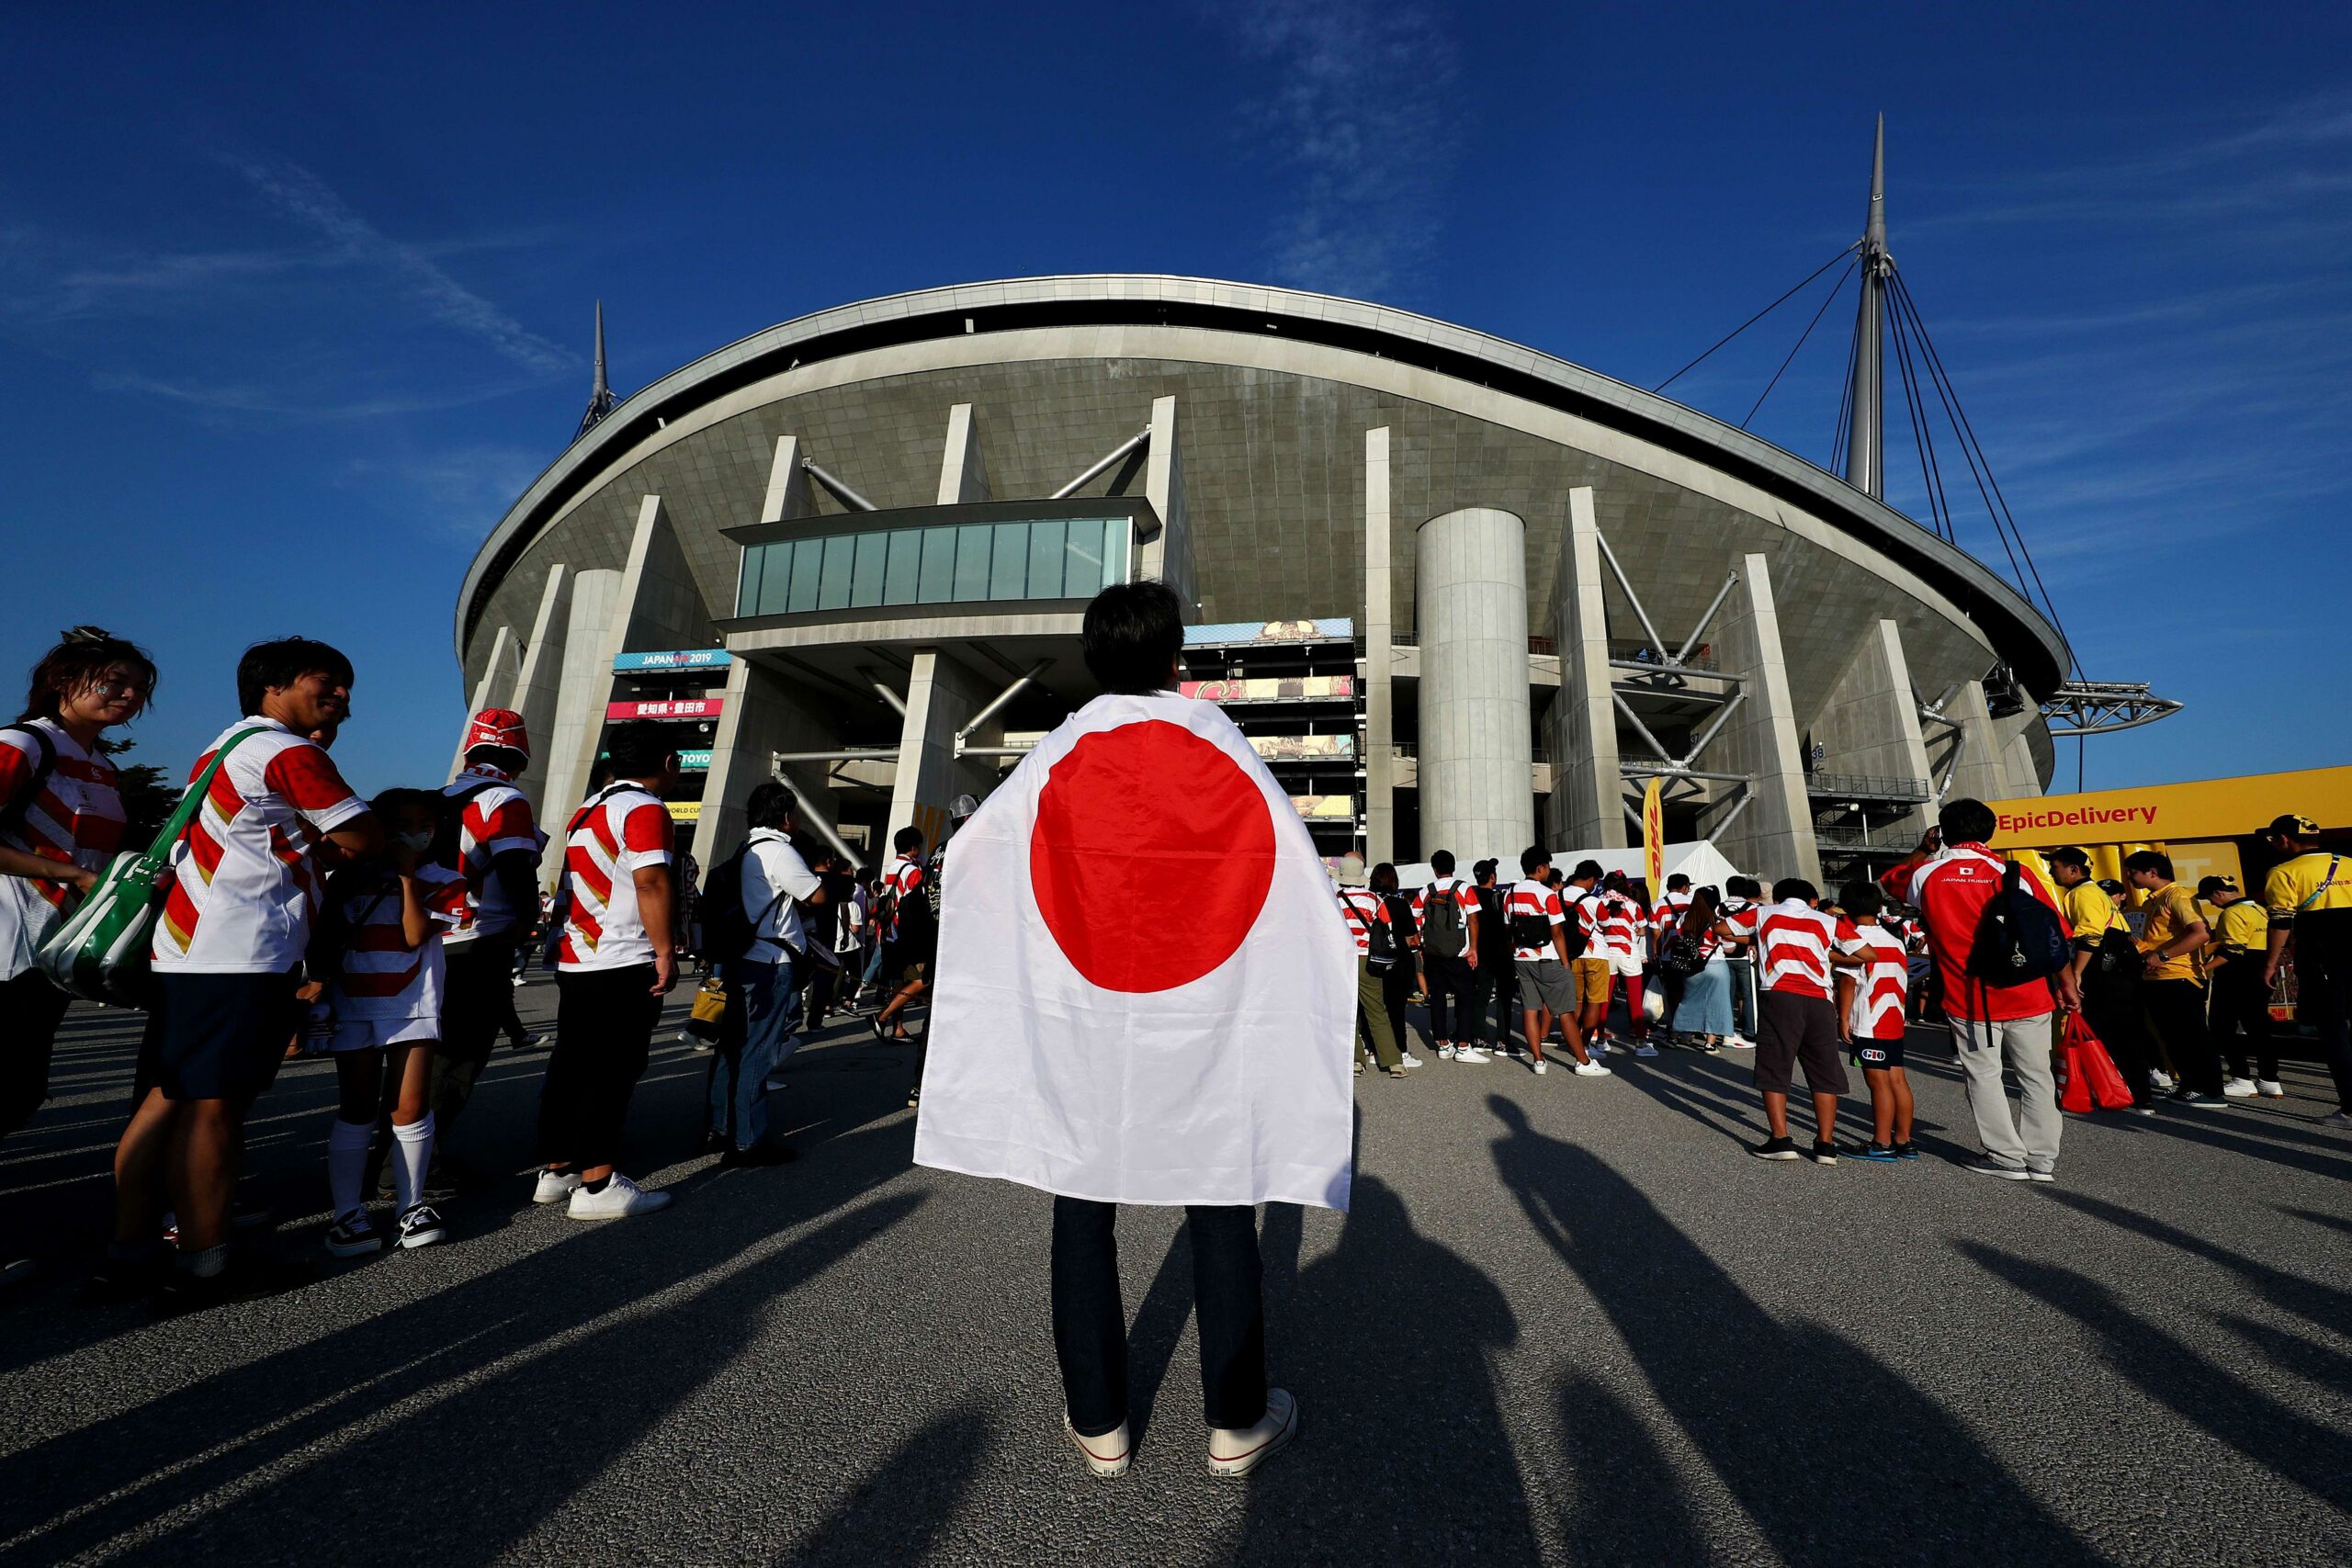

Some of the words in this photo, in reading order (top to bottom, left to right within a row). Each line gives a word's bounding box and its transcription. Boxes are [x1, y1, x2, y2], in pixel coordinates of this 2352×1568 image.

[642, 655, 674, 665] JAPAN
[689, 653, 712, 663] 2019
[637, 702, 706, 716] 愛知県・豊田市
[682, 753, 713, 763] TOYO
[1812, 748, 1824, 760] 38
[1996, 806, 2157, 833] EpicDelivery
[1649, 805, 1661, 880] DHL
[1220, 1467, 1231, 1476] STAR
